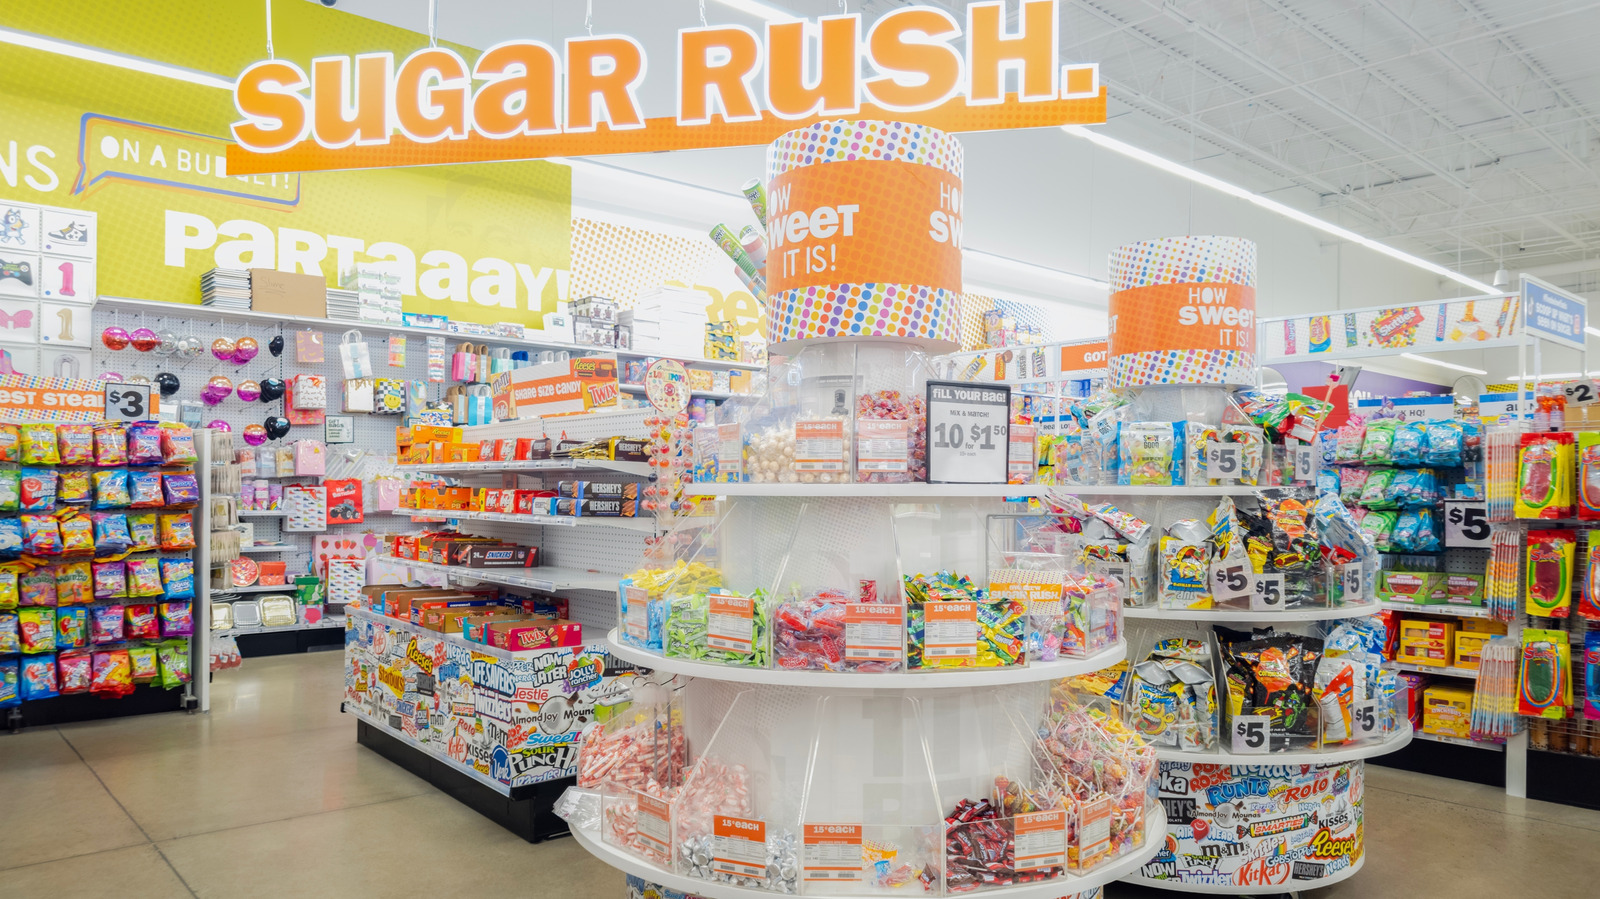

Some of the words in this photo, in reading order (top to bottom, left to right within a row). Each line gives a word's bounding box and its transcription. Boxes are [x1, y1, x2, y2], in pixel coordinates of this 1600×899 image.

[101, 136, 139, 163] ON
[150, 145, 167, 168] A
[783, 248, 801, 279] IT
[806, 244, 837, 274] IS!
[1189, 287, 1228, 305] HOW
[1379, 310, 1417, 337] Skittles
[1219, 329, 1234, 346] IT
[1236, 330, 1249, 348] IS!
[574, 358, 596, 371] Reese's
[1084, 351, 1108, 363] GOT
[109, 389, 144, 418] $3
[588, 382, 618, 408] Twix
[954, 390, 981, 401] YOUR
[1565, 384, 1594, 402] $2
[1410, 409, 1425, 417] HQ!
[934, 422, 964, 449] 10
[1211, 449, 1237, 473] $5
[1299, 452, 1311, 476] $5
[591, 483, 622, 494] HERSHEY'S
[589, 501, 620, 511] HERSHEY'S
[1449, 506, 1491, 541] $5
[486, 551, 514, 559] SNICKERS
[1216, 565, 1248, 592] $5
[1347, 569, 1360, 594] $5
[1256, 580, 1280, 606] $5
[518, 629, 548, 646] Twix
[407, 638, 433, 674] Reese's
[533, 651, 564, 671] NOW
[533, 665, 568, 687] LATER
[569, 664, 595, 679] JOLLY
[570, 673, 598, 687] rancher
[511, 714, 543, 727] Almond
[544, 712, 559, 723] Joy
[1356, 706, 1375, 732] $5
[1236, 722, 1265, 748] $5
[508, 746, 578, 775] PUNCH
[522, 745, 556, 758] SOUR
[1206, 776, 1270, 807] RUNTS
[1284, 778, 1329, 802] Rolo
[1255, 818, 1304, 834] SMARTIES
[1319, 813, 1349, 829] KISSES
[1176, 826, 1194, 840] AIR
[1312, 829, 1355, 857] Reese's
[1141, 862, 1175, 878] NOW
[1238, 860, 1282, 886] KitKat
